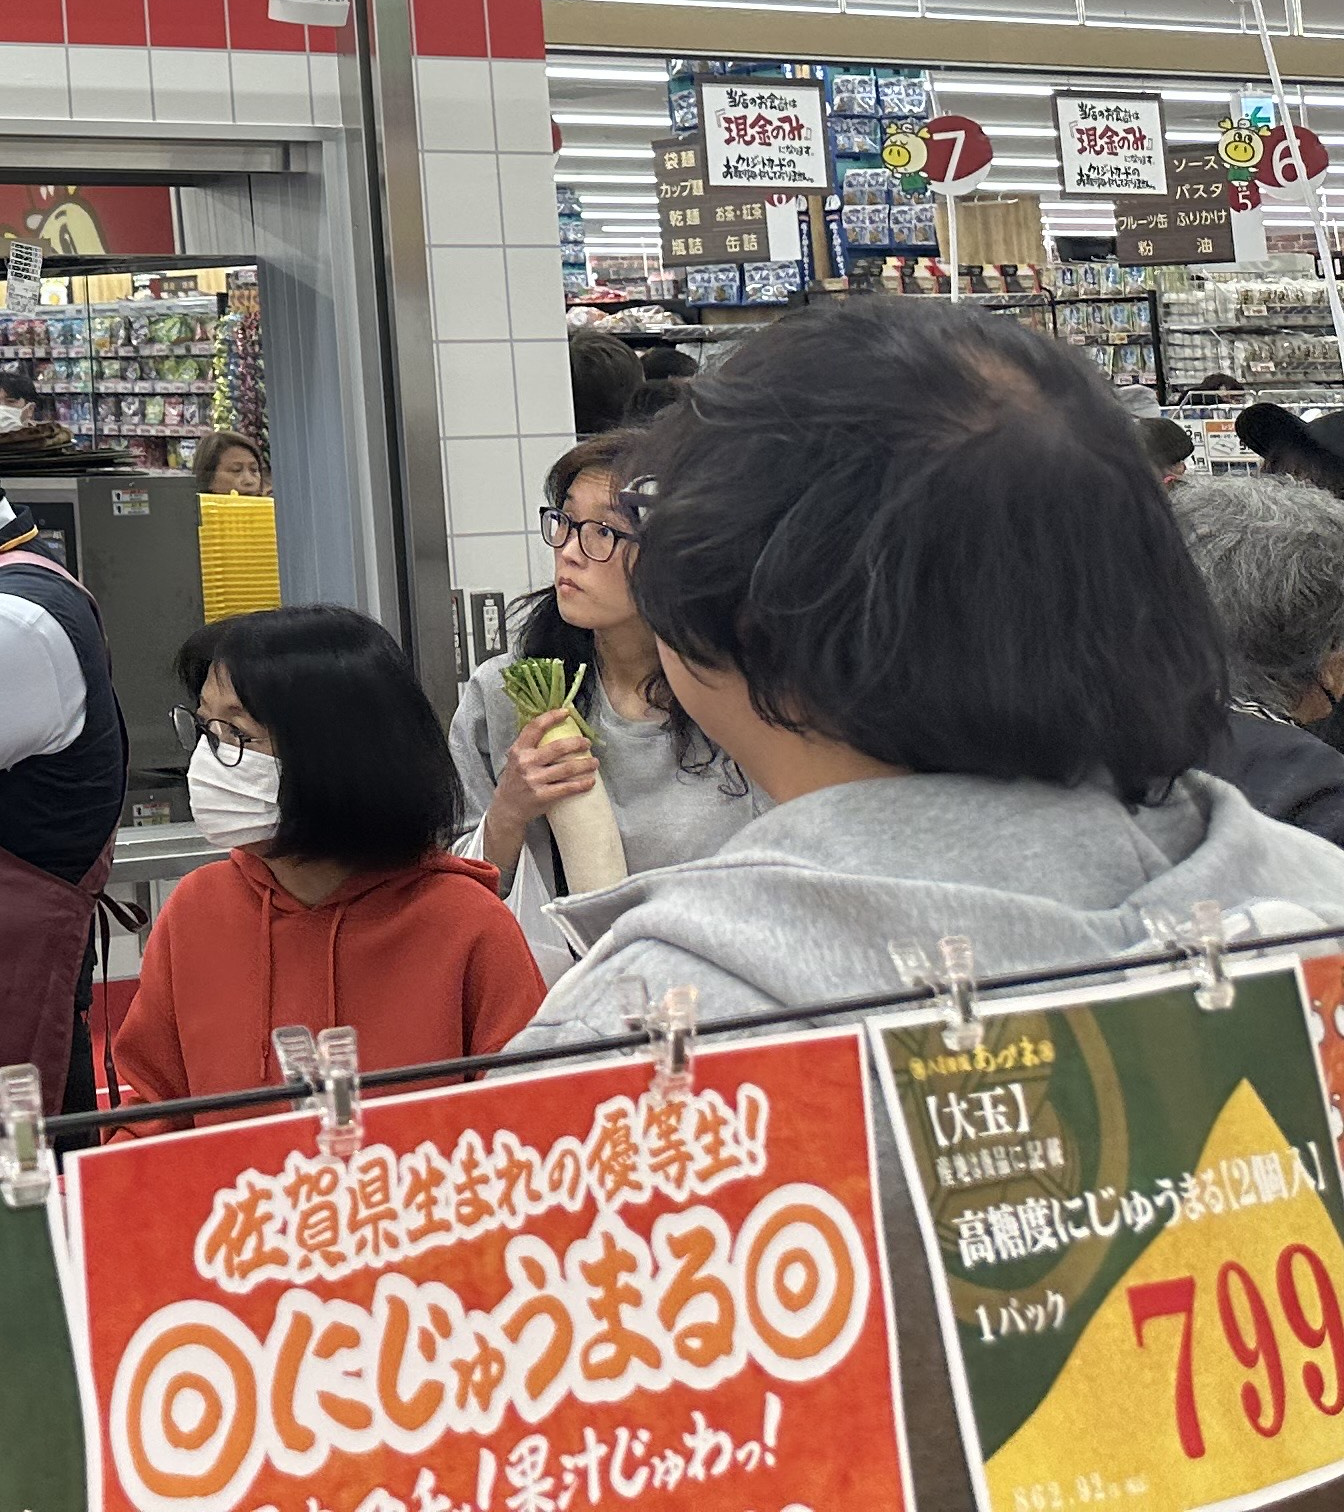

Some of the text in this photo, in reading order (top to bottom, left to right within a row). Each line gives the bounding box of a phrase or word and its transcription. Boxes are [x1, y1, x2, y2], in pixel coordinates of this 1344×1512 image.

[932, 130, 965, 183] 7
[1173, 155, 1219, 172] ソース
[1272, 139, 1302, 188] 6
[660, 179, 704, 198] カップ麺
[1176, 183, 1223, 199] パスタ
[1238, 191, 1252, 211] 5
[715, 204, 762, 222] お茶・紅茶
[1118, 213, 1168, 230] フルーツ缶
[1176, 209, 1227, 226] ふりかけ
[726, 233, 758, 252] 缶詰
[1138, 240, 1153, 256] 粉
[1197, 238, 1213, 253] 油
[975, 1290, 1067, 1343] 1パック
[1126, 1243, 1344, 1459] 799
